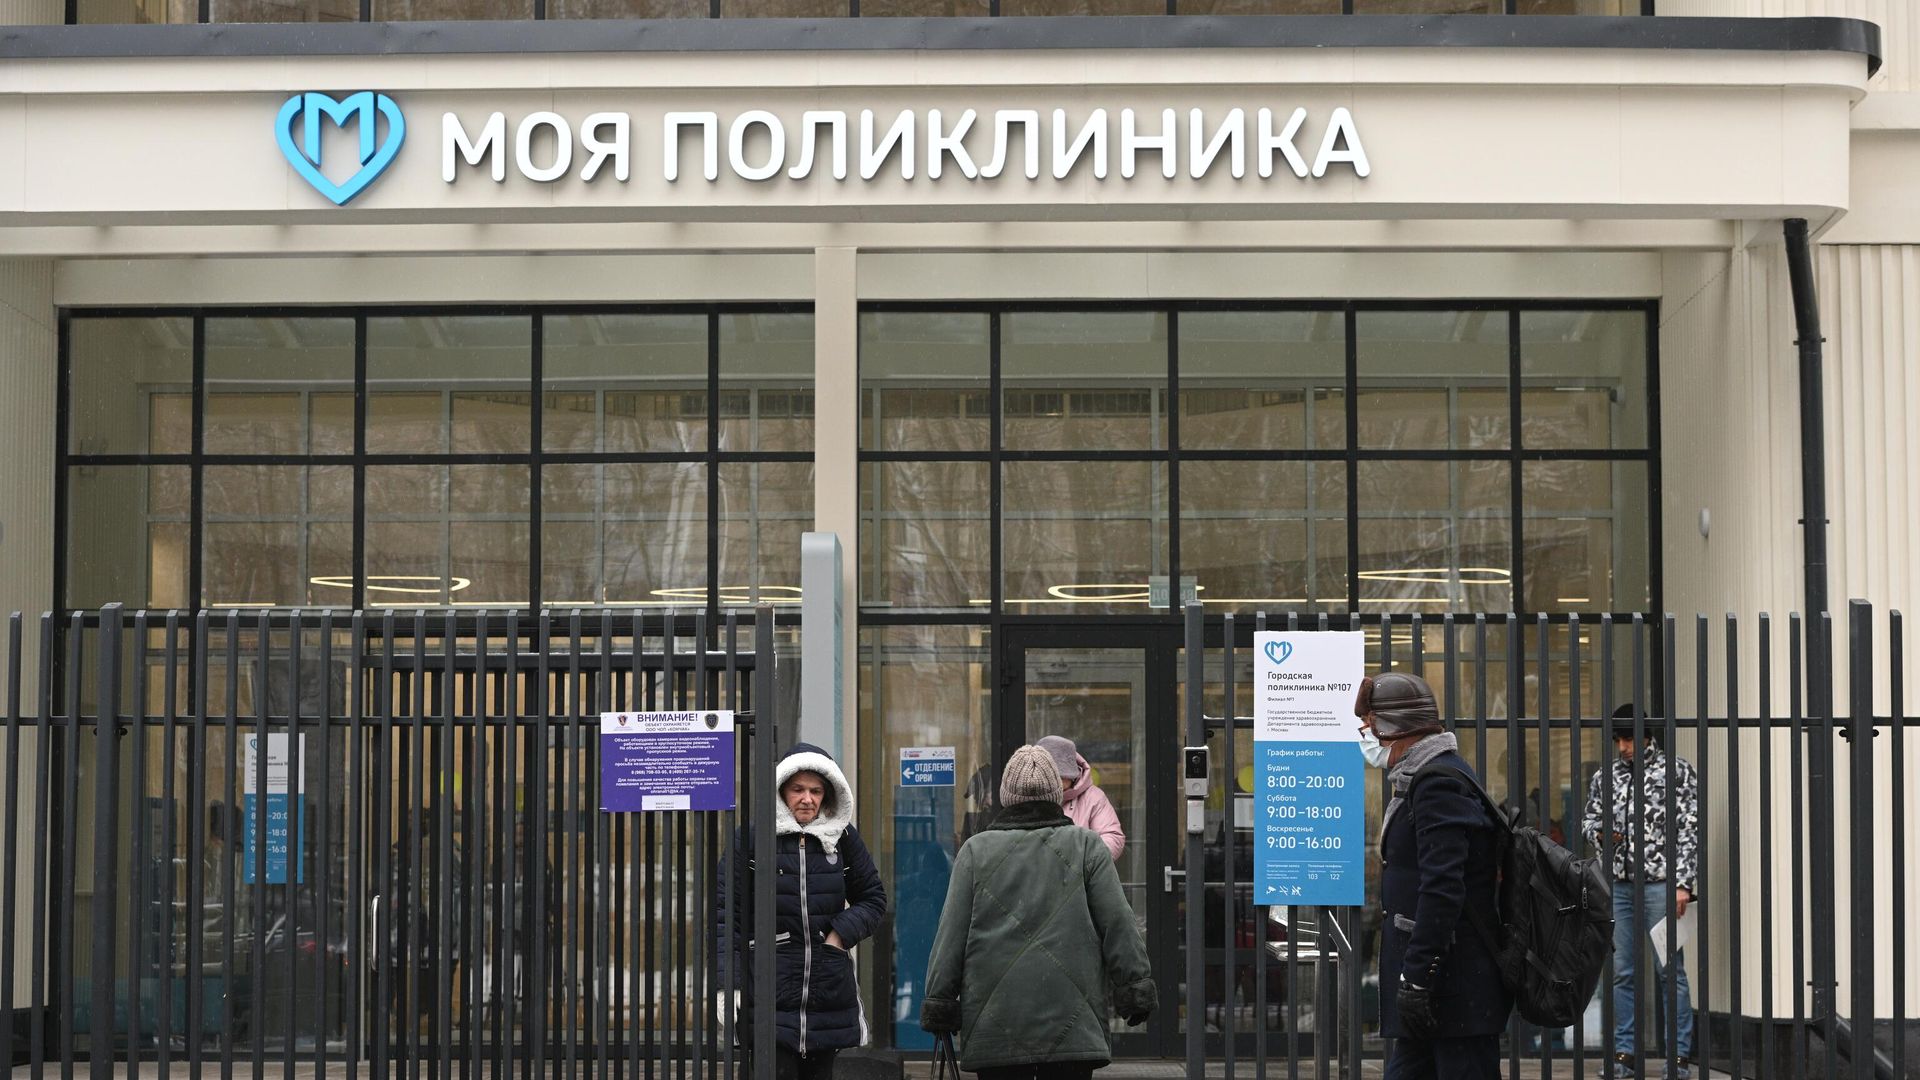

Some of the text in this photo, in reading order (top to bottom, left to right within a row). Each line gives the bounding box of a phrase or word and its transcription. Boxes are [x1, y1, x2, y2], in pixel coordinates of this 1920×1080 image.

[442, 107, 1369, 182] МОЯ ПОЛИКЛИНИКА
[1268, 672, 1312, 681] Городская
[1328, 683, 1352, 691] №107
[637, 713, 698, 722] ВНИМАНИЕ!
[1267, 749, 1294, 757] График
[914, 762, 954, 772] ОТДЕЛЕНИЕ
[1267, 764, 1290, 772] Будни
[914, 774, 932, 782] ОРВИ
[1267, 825, 1314, 833] Воскресенье
